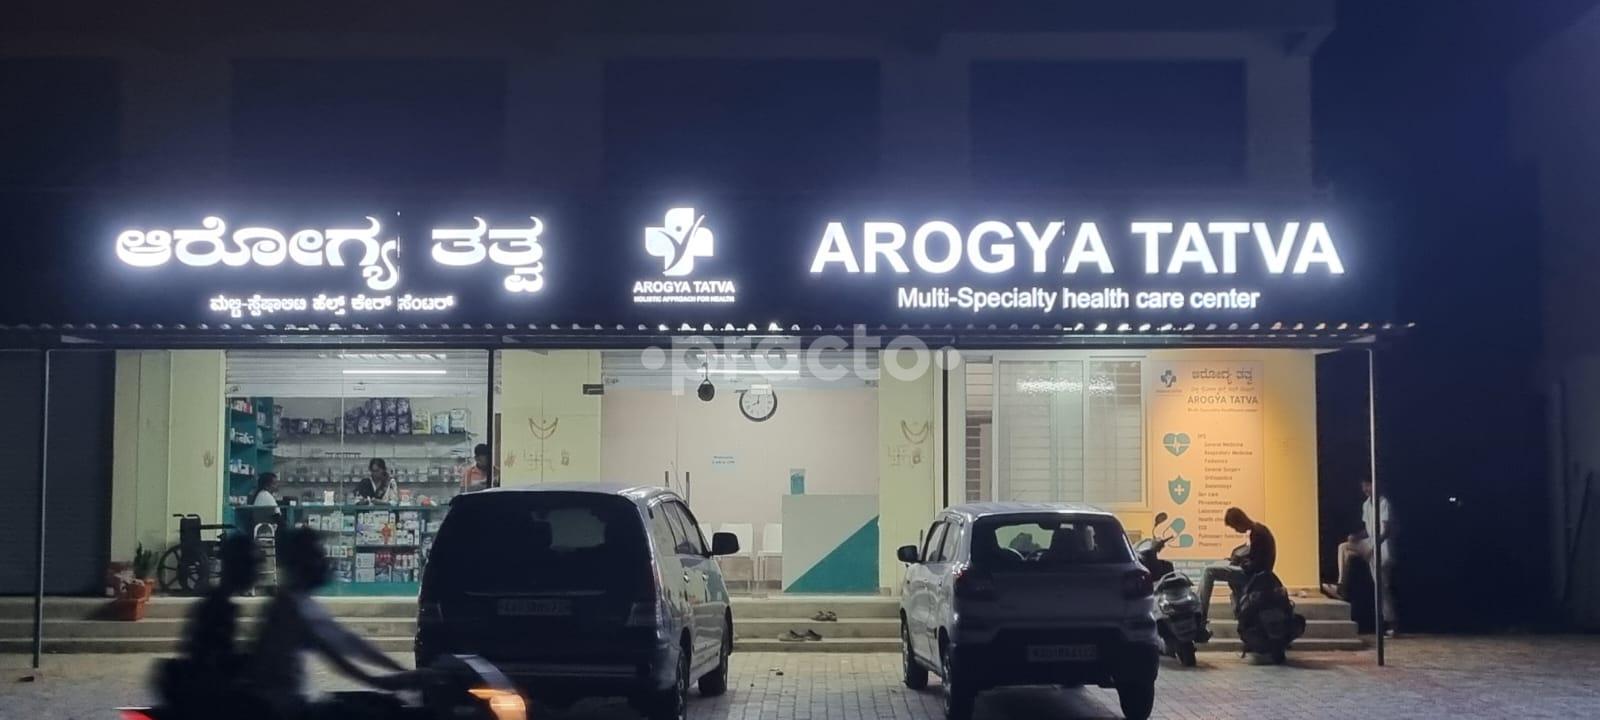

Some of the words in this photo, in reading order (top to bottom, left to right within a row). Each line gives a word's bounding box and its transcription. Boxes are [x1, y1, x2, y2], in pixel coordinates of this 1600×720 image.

[116, 216, 400, 290] ಆರೋಗ್ಯ
[810, 220, 1115, 275] AROGYA
[1131, 221, 1345, 275] TATVA
[633, 280, 692, 294] AROGYA
[693, 280, 736, 294] TATVA
[897, 287, 1057, 313] Multi-Specialty
[1062, 287, 1129, 310] health
[1136, 290, 1185, 310] care
[1190, 288, 1260, 310] center
[1187, 395, 1228, 405] AROGYA
[1230, 395, 1259, 405] TATVA
